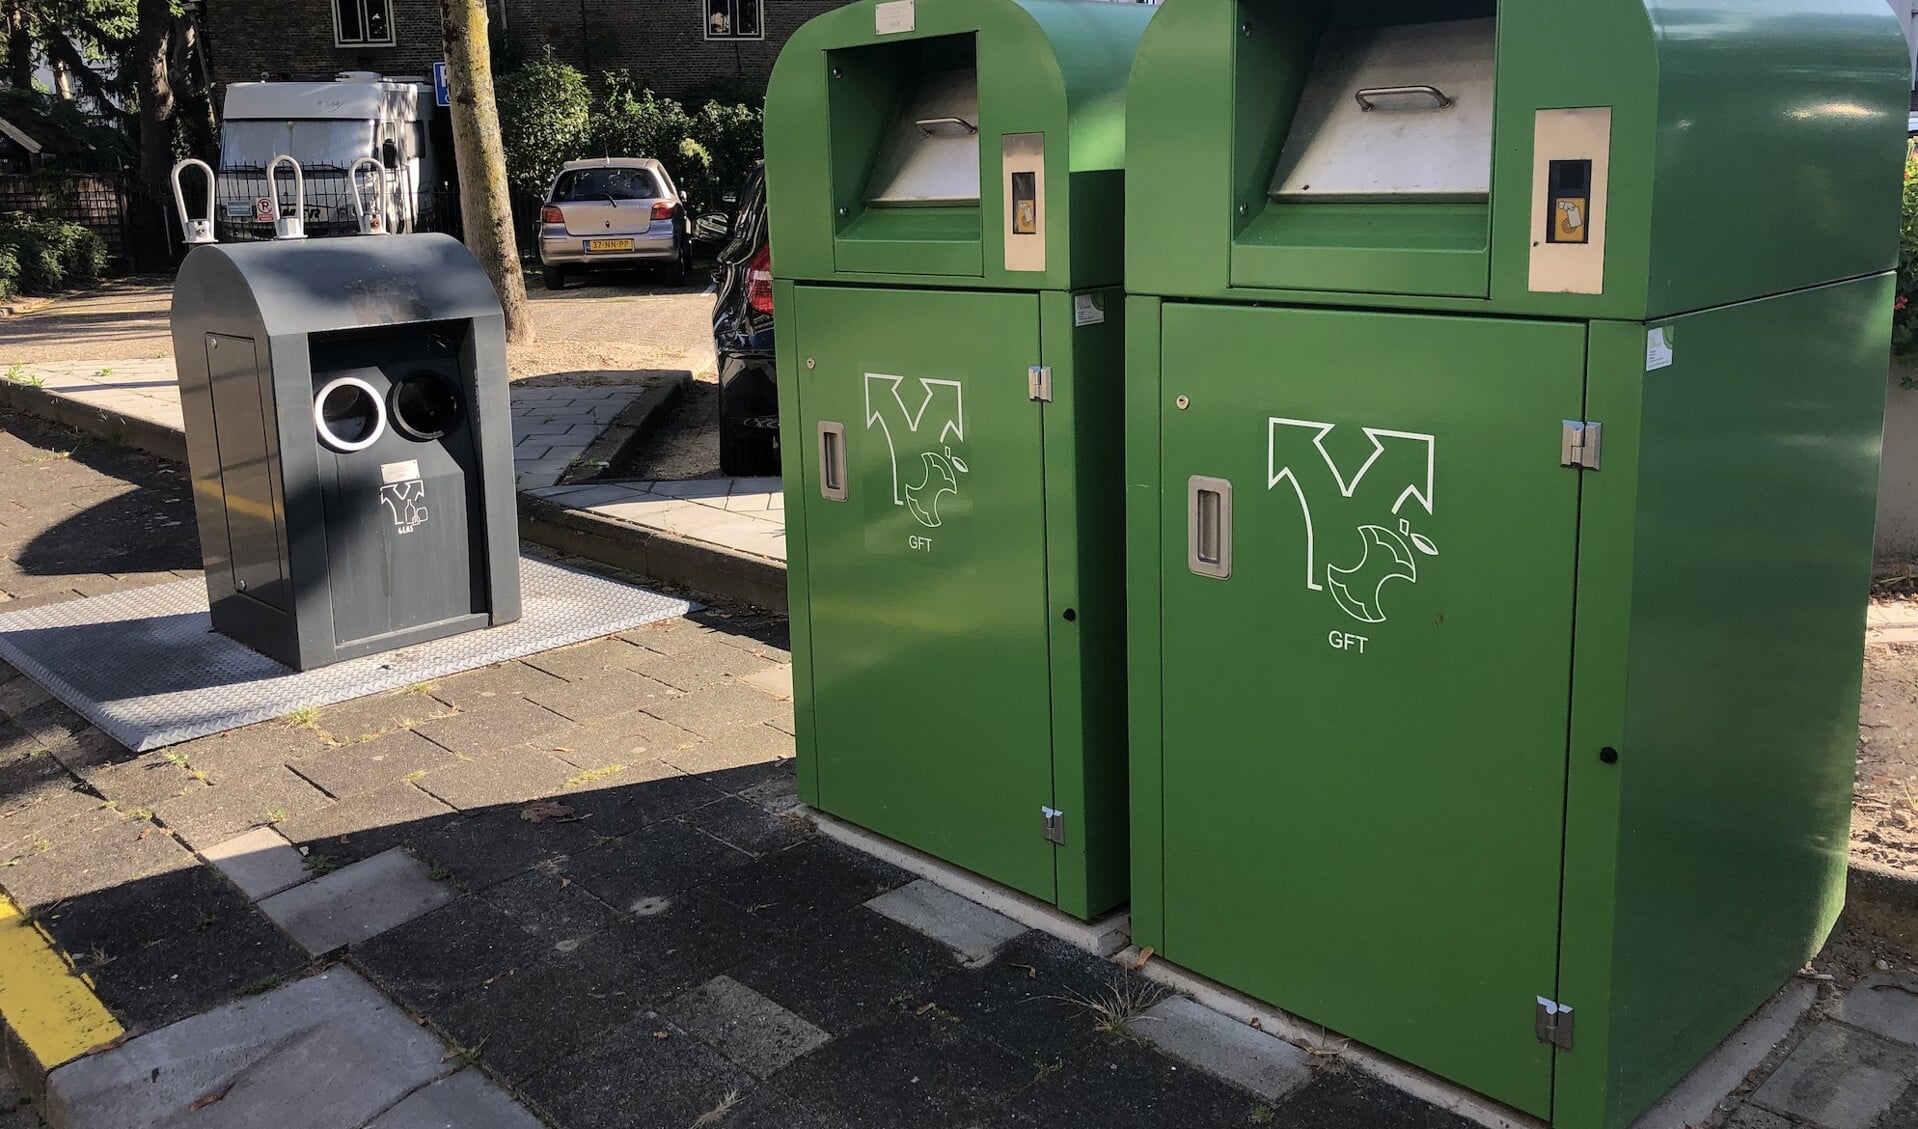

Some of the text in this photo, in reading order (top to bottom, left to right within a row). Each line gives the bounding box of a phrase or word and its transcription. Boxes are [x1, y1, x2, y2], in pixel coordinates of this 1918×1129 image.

[592, 240, 630, 249] 37-NN-PP
[398, 524, 415, 535] GLAS
[909, 535, 933, 552] GFT
[1328, 630, 1369, 654] GFT
